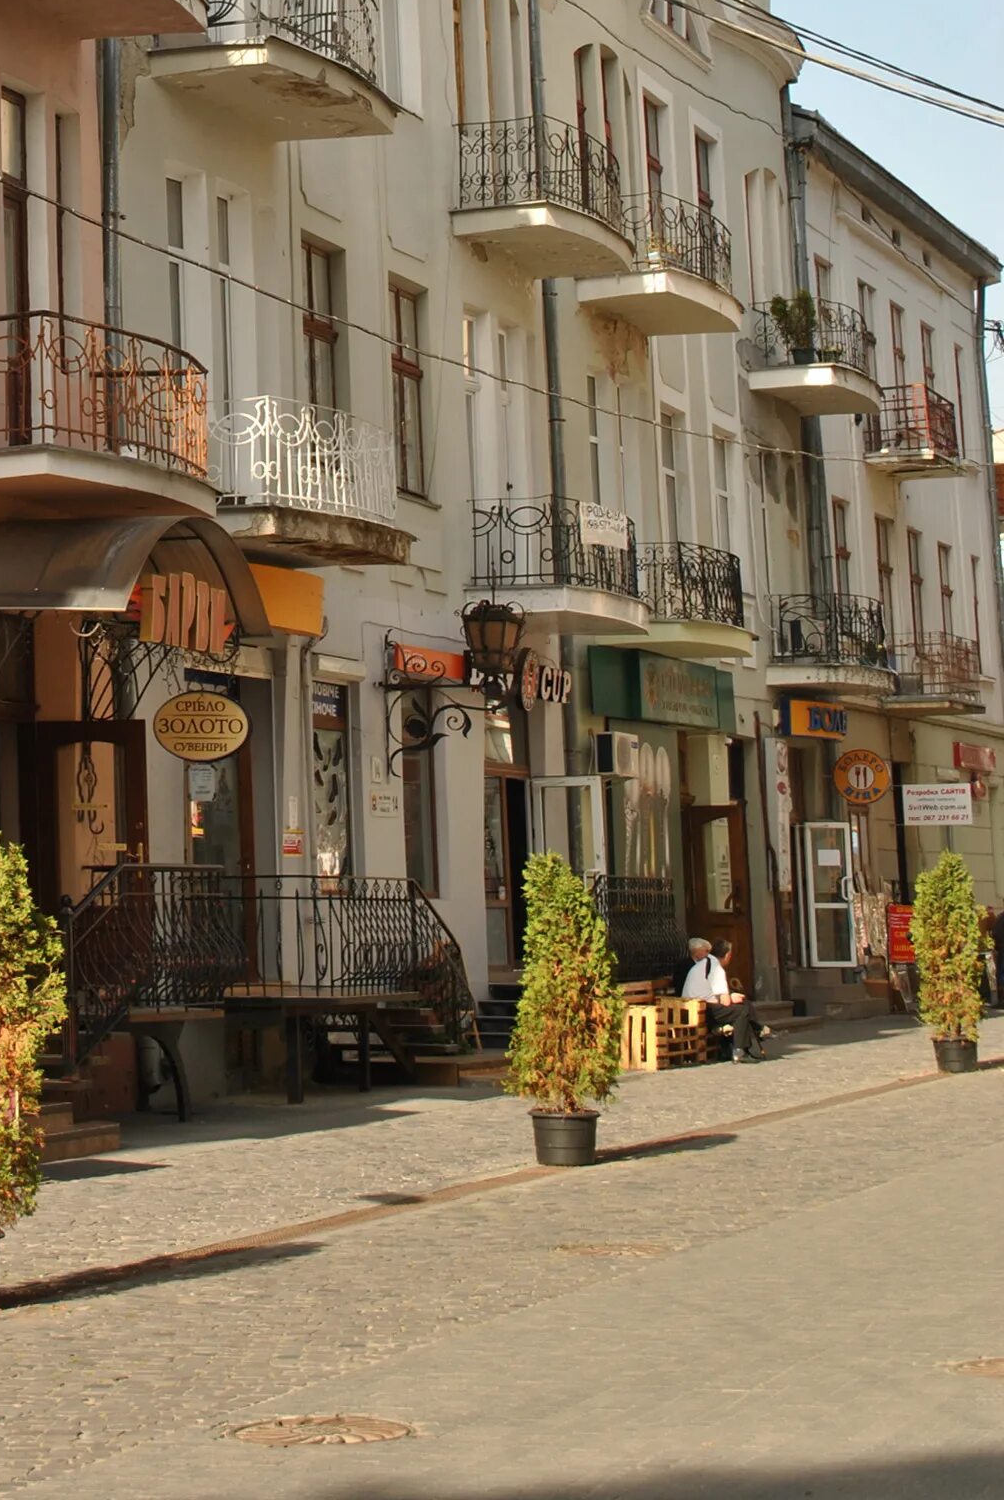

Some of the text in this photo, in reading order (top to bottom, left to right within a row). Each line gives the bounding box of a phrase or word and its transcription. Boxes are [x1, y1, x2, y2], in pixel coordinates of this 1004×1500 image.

[540, 665, 572, 704] CUP
[175, 699, 226, 713] СРІБЛО
[158, 717, 244, 735] ЗОЛОТО
[173, 741, 228, 753] СУВЕНІРИ
